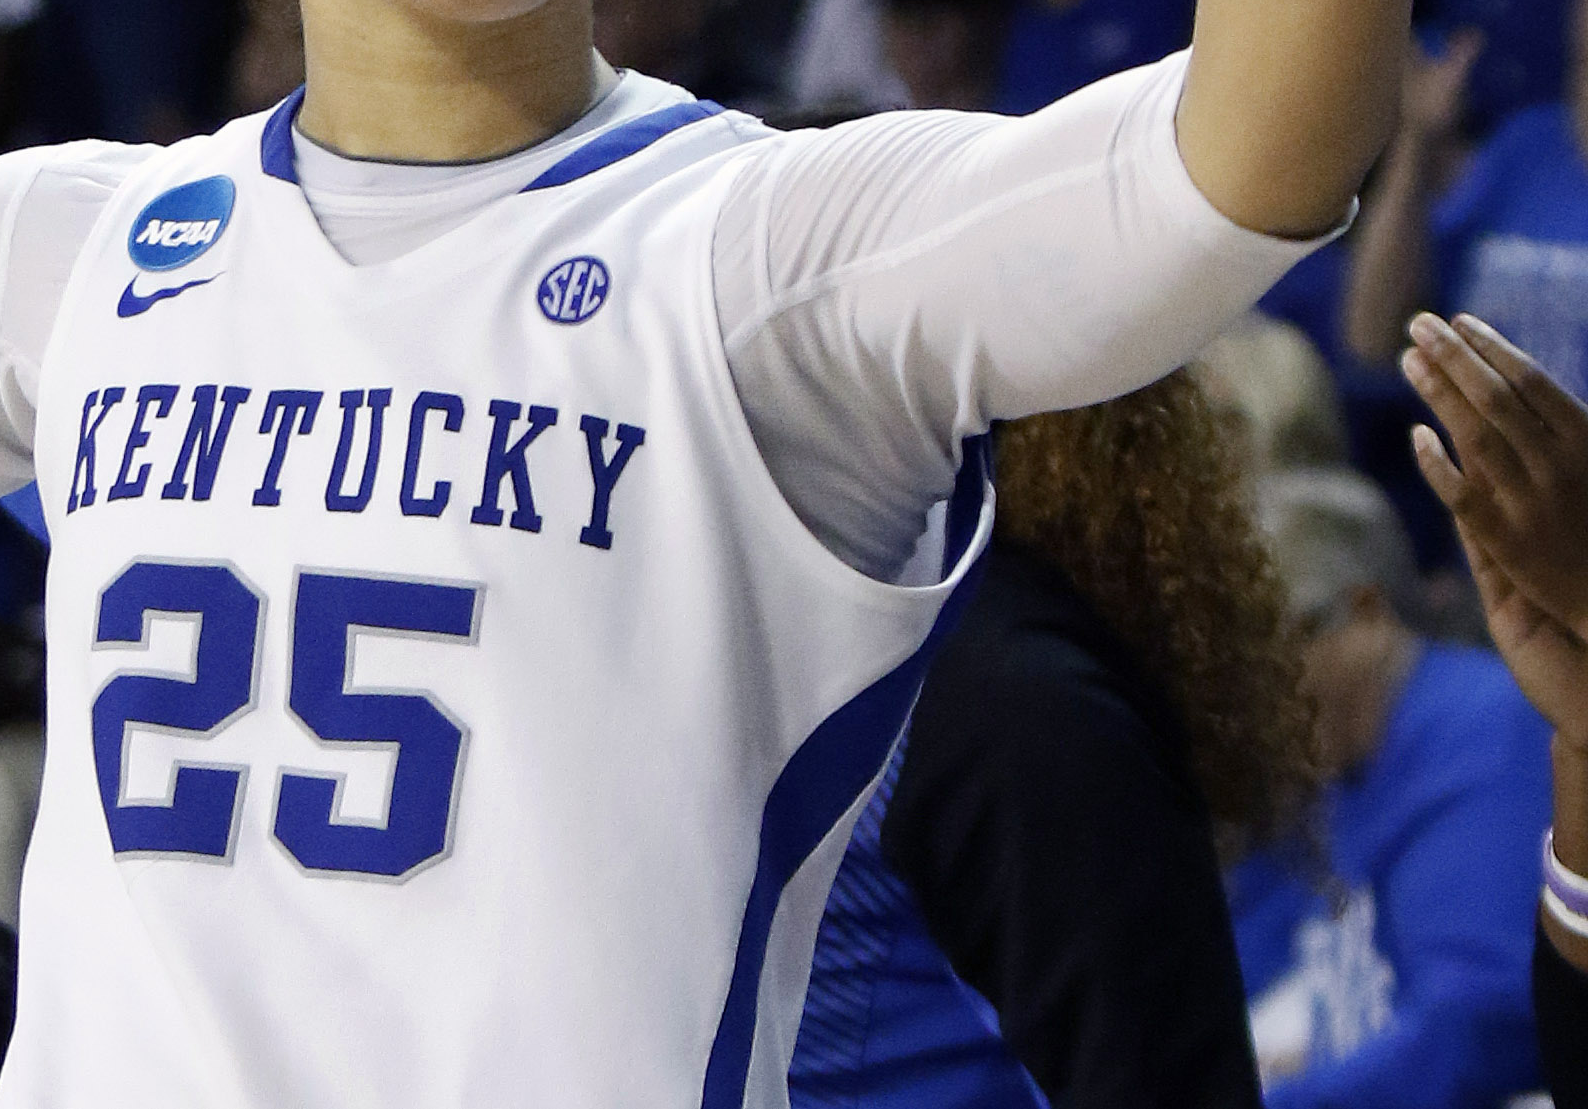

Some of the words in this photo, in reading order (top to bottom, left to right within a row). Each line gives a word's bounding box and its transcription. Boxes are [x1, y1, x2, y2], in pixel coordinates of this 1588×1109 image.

[135, 217, 222, 249] NCAA
[541, 259, 608, 320] SEC
[66, 383, 646, 551] KENTUCKY
[90, 554, 487, 886] 25
